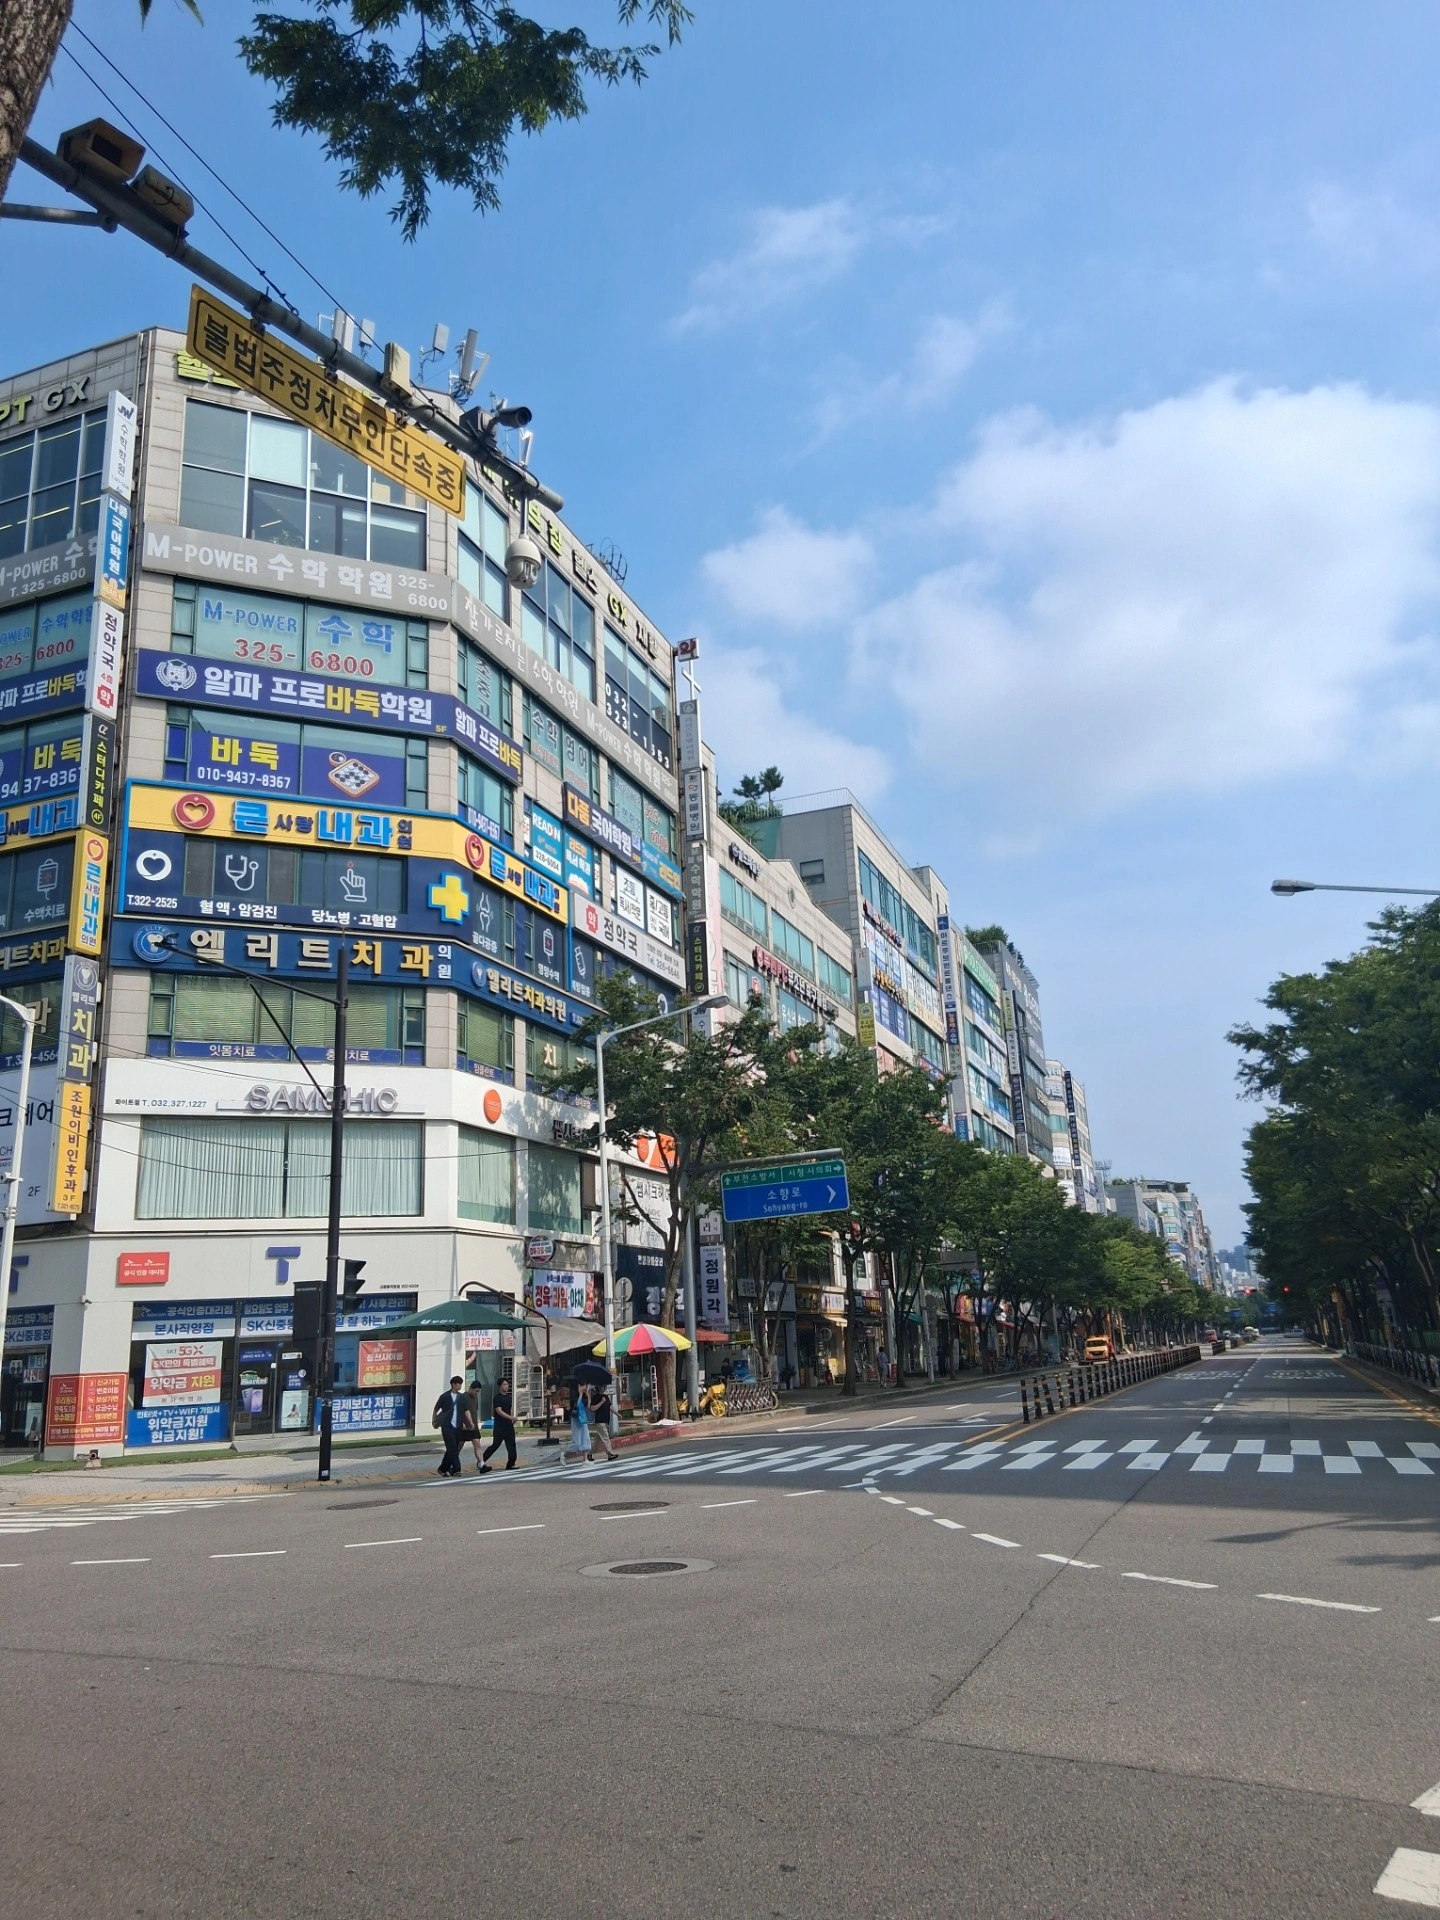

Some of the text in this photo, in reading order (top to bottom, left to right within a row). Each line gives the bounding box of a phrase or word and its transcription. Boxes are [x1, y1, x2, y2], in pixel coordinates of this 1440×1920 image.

[42, 377, 90, 413] GX
[203, 315, 455, 502] 불법주정차무인단속중
[147, 531, 258, 576] M-POWER
[21, 567, 86, 595] 325-6800
[203, 598, 298, 634] M-POWER
[407, 592, 448, 611] 6800
[608, 593, 629, 628] GX
[101, 612, 118, 671] 정약국
[318, 613, 396, 653] 수학
[36, 638, 75, 660] 6800
[309, 648, 375, 678] 6800
[203, 667, 432, 726] 알파 프로바둑학원
[92, 741, 108, 809] 스터디카페
[197, 766, 291, 790] 010-9437-8367
[126, 894, 178, 909] T.322-2525
[604, 916, 638, 957] 정약국
[68, 1008, 93, 1078] 치과
[209, 1044, 256, 1058] 잇몸치료
[326, 1050, 370, 1061] 충치료
[63, 1090, 84, 1194] 조원이비인후과
[27, 1186, 41, 1197] 2F
[766, 1186, 803, 1201] 소향로
[762, 1201, 809, 1214] Sohyang-ro
[704, 1259, 721, 1315] 정원각
[154, 1321, 215, 1337] 본사직영점
[150, 1374, 216, 1391] 위약금 지원
[148, 1415, 209, 1430] 위약금지원
